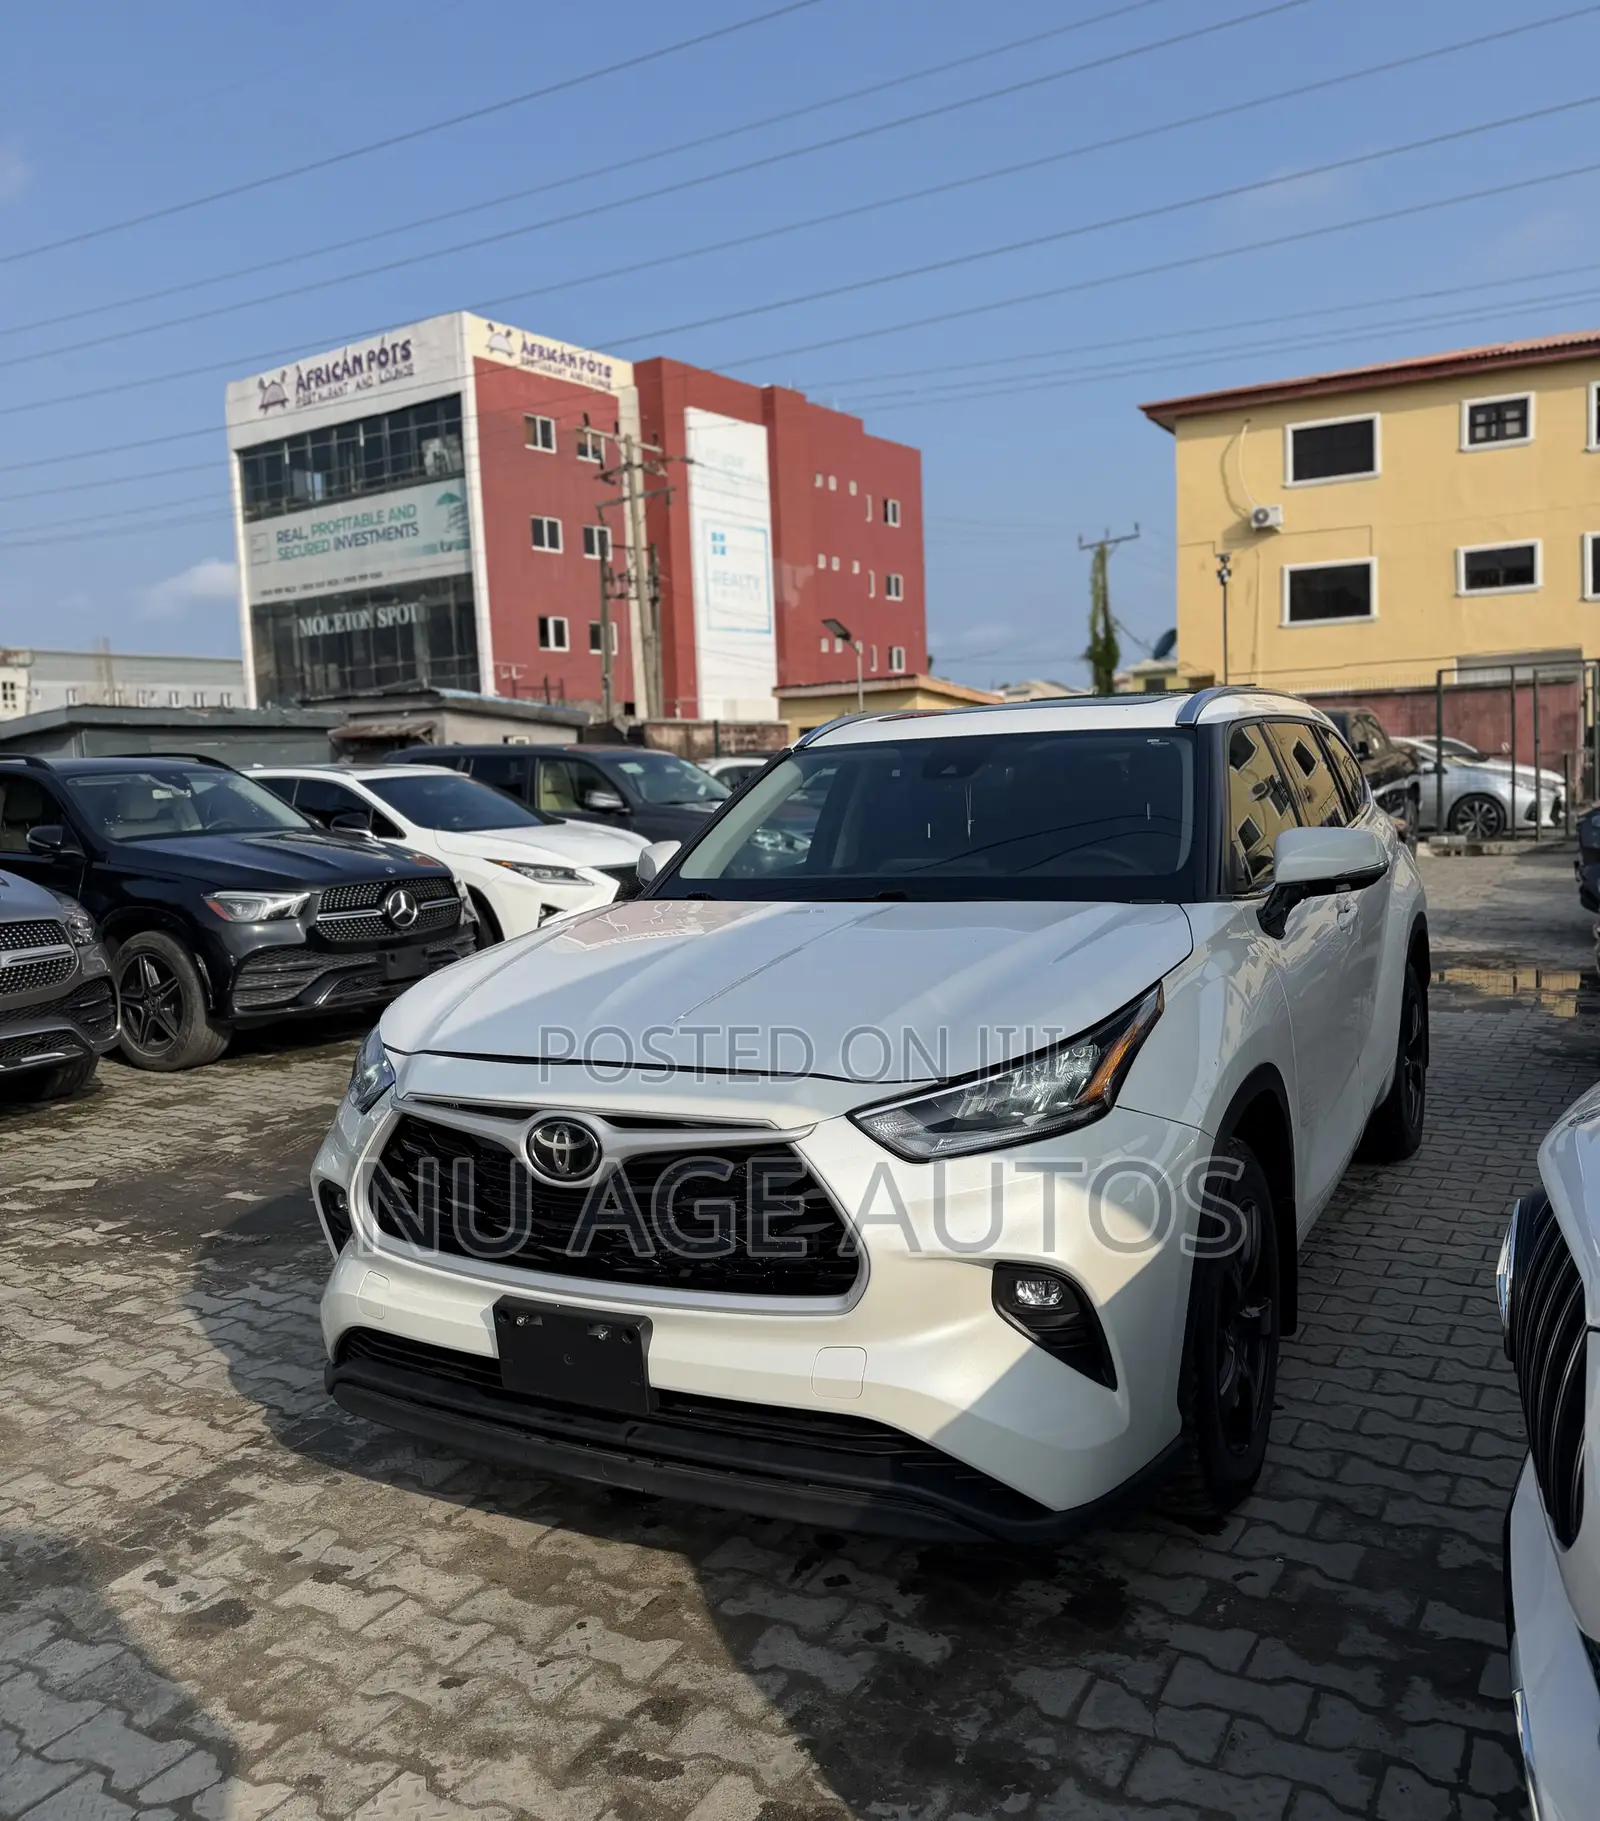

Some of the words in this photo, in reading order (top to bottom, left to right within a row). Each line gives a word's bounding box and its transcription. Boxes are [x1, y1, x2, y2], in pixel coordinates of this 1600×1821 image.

[311, 509, 384, 538] PROFITABLE
[388, 504, 416, 523] AND
[277, 538, 330, 561] SECURED
[333, 522, 419, 551] INVESTMENTS
[377, 603, 419, 628] SPOT
